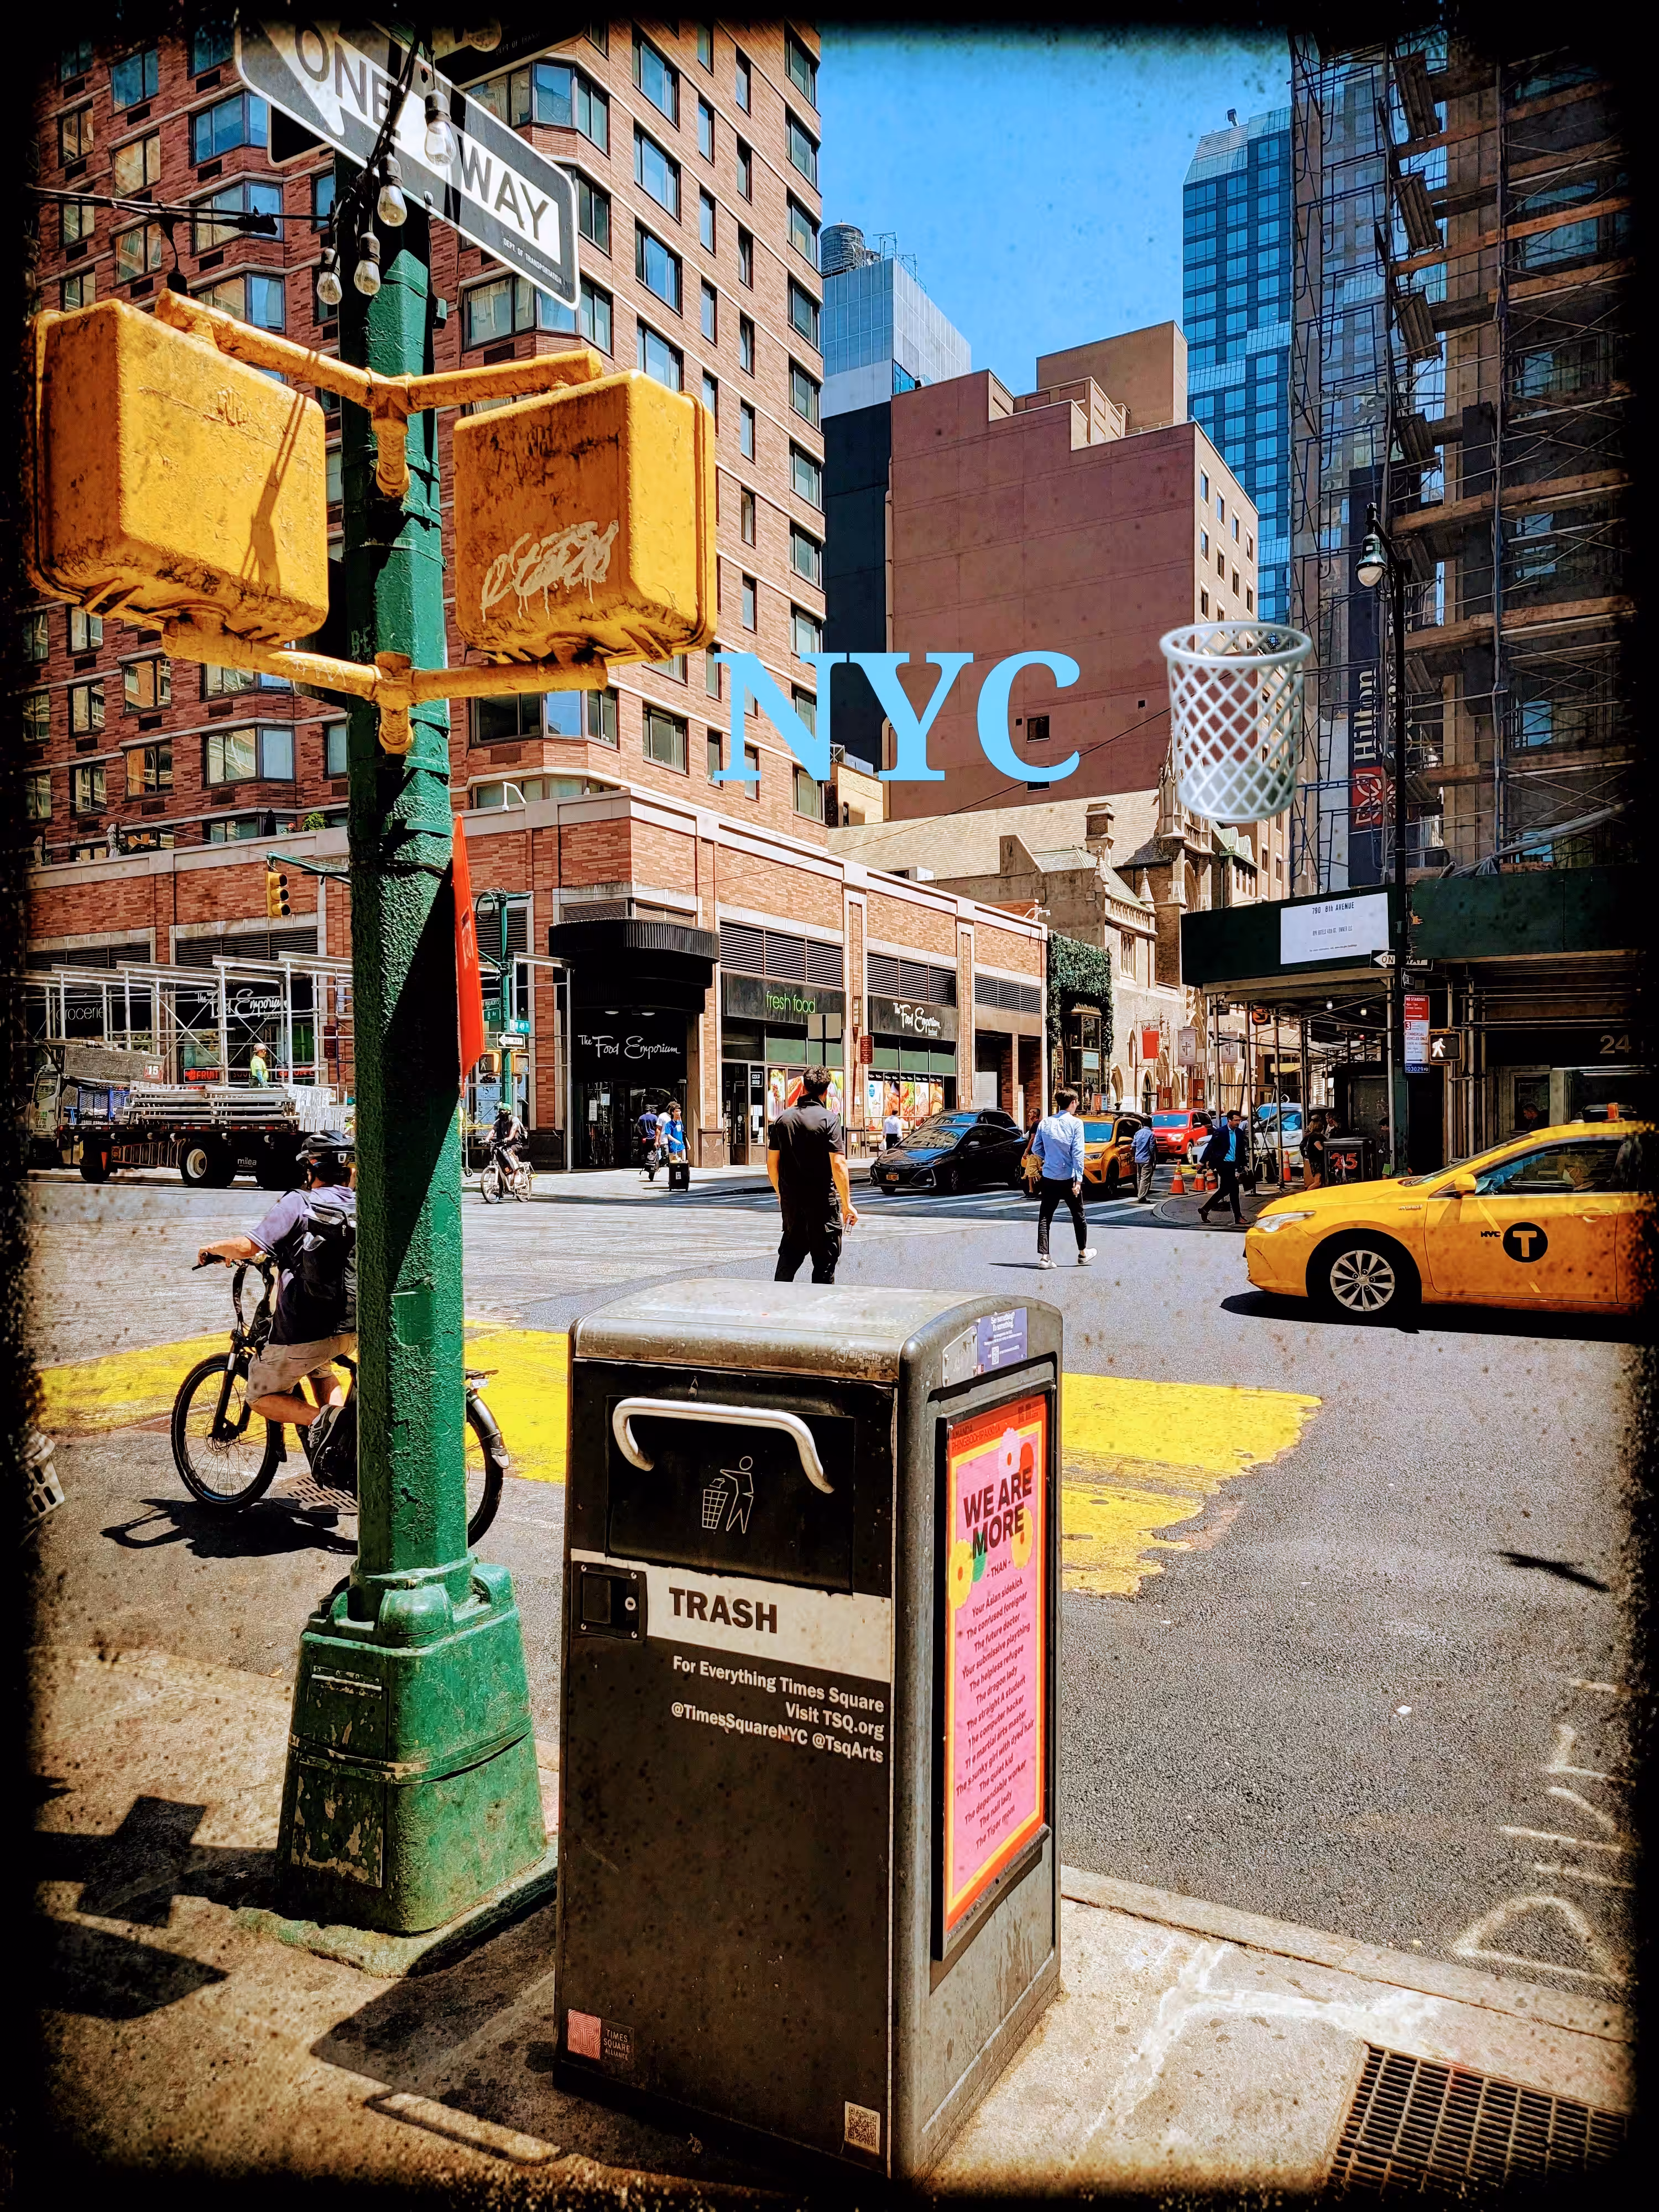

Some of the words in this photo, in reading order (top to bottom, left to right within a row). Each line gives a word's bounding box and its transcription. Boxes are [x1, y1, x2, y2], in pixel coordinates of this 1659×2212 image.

[295, 21, 400, 140] ONE
[457, 133, 549, 242] WAY
[503, 238, 516, 252] DEPT.
[518, 248, 524, 257] OF
[525, 253, 562, 284] TRANSPORTATION
[1354, 667, 1376, 763] Hilton
[1335, 902, 1354, 911] AVENUE
[487, 1011, 491, 1020] 8
[766, 990, 791, 1010] fresh
[793, 994, 816, 1013] food
[893, 1002, 901, 1014] The
[899, 1004, 914, 1028] Food
[915, 1007, 941, 1033] Emporium
[578, 1035, 592, 1045] The
[592, 1036, 619, 1057] Food
[624, 1036, 681, 1059] Emporium
[148, 1066, 159, 1075] 15
[238, 1157, 257, 1165] milea
[1330, 1152, 1358, 1170] 25
[1513, 1231, 1537, 1257] T
[963, 1484, 994, 1528] WE
[998, 1465, 1032, 1512] ARE
[973, 1501, 1024, 1561] MORE
[991, 1559, 1007, 1577] THAN
[669, 1587, 778, 1634] TRASH
[967, 1627, 977, 1640] The
[978, 1606, 1003, 1631] confused
[1004, 1591, 1027, 1614] foreigner
[972, 1603, 984, 1618] Your
[986, 1593, 1001, 1608] Asian
[1001, 1576, 1023, 1597] sidekick
[962, 1664, 975, 1680] Your
[976, 1641, 1005, 1669] submissive
[1006, 1623, 1030, 1648] plaything
[974, 1639, 984, 1652] The
[985, 1626, 1002, 1644] future
[1003, 1613, 1020, 1631] doctor
[674, 1656, 696, 1673] For
[700, 1662, 776, 1692] Everything
[779, 1676, 825, 1700] Times
[829, 1688, 884, 1713] Square
[969, 1678, 979, 1692] The
[981, 1660, 1003, 1683] helpless
[1004, 1644, 1023, 1665] refugee
[976, 1692, 986, 1705] The
[987, 1675, 1005, 1697] dragon
[1006, 1666, 1018, 1680] lady
[786, 1702, 820, 1723] Visit
[822, 1710, 884, 1740] TSQ.org
[967, 1717, 977, 1731] The
[978, 1695, 999, 1721] straight
[1001, 1692, 1004, 1703] A
[1006, 1674, 1025, 1698] student
[980, 1710, 1005, 1738] computer
[1006, 1694, 1024, 1715] hacker
[671, 1702, 808, 1745] @TimesSquareNYC
[812, 1732, 884, 1763] @TsqArts
[977, 1734, 996, 1759] martial
[997, 1726, 1008, 1741] arts
[1009, 1709, 1026, 1730] master
[956, 1781, 967, 1796] The
[989, 1749, 998, 1768] girl
[999, 1740, 1010, 1756] with
[1011, 1726, 1023, 1745] dyed
[1025, 1718, 1034, 1733] hair
[979, 1778, 989, 1792] The
[990, 1762, 1004, 1782] quiet
[1005, 1752, 1013, 1768] kid
[965, 1810, 975, 1825] The
[976, 1778, 1007, 1814] dependable
[1008, 1760, 1026, 1782] worker
[980, 1813, 989, 1827] The
[991, 1799, 1000, 1817] nail
[1001, 1790, 1012, 1806] lady
[976, 1834, 986, 1849] The
[987, 1819, 1001, 1837] Tiger
[1002, 1804, 1015, 1823] mom
[603, 2038, 630, 2053] SQUARE
[605, 2048, 628, 2061] ALLIANCE
[607, 2030, 628, 2043] TIMES
